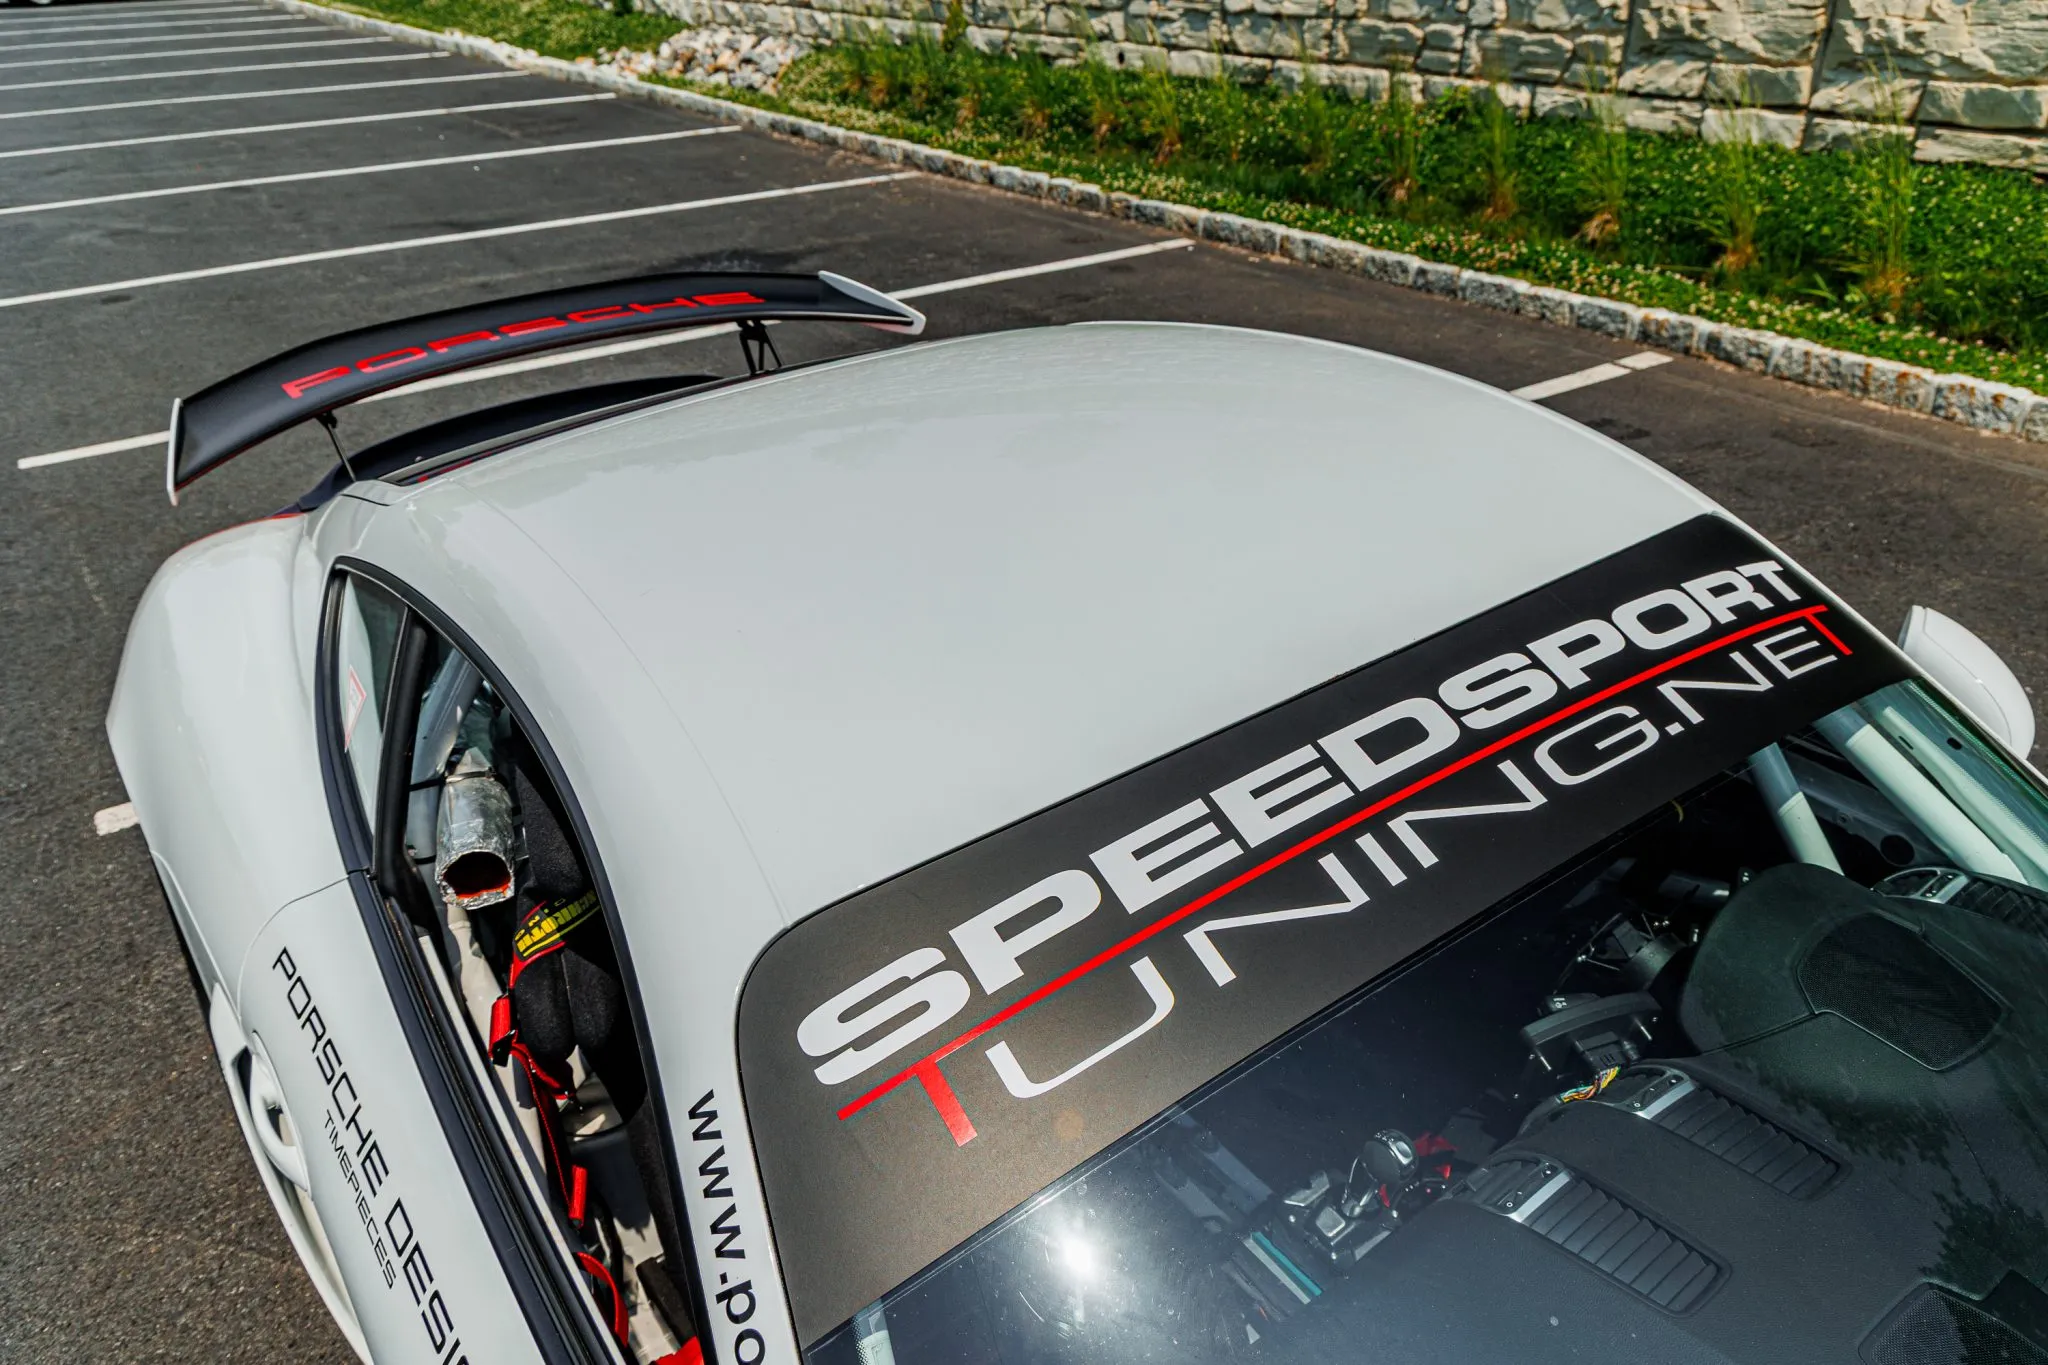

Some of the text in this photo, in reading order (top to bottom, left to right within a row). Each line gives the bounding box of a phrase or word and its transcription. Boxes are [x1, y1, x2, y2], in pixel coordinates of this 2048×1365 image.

[281, 291, 764, 399] PORSCHE
[797, 559, 1801, 1086] SPEEDSPORT
[836, 604, 1853, 1147] TUNING.NET
[272, 946, 469, 1365] PORSCHE DESI
[324, 1109, 397, 1289] TIMEPIECES
